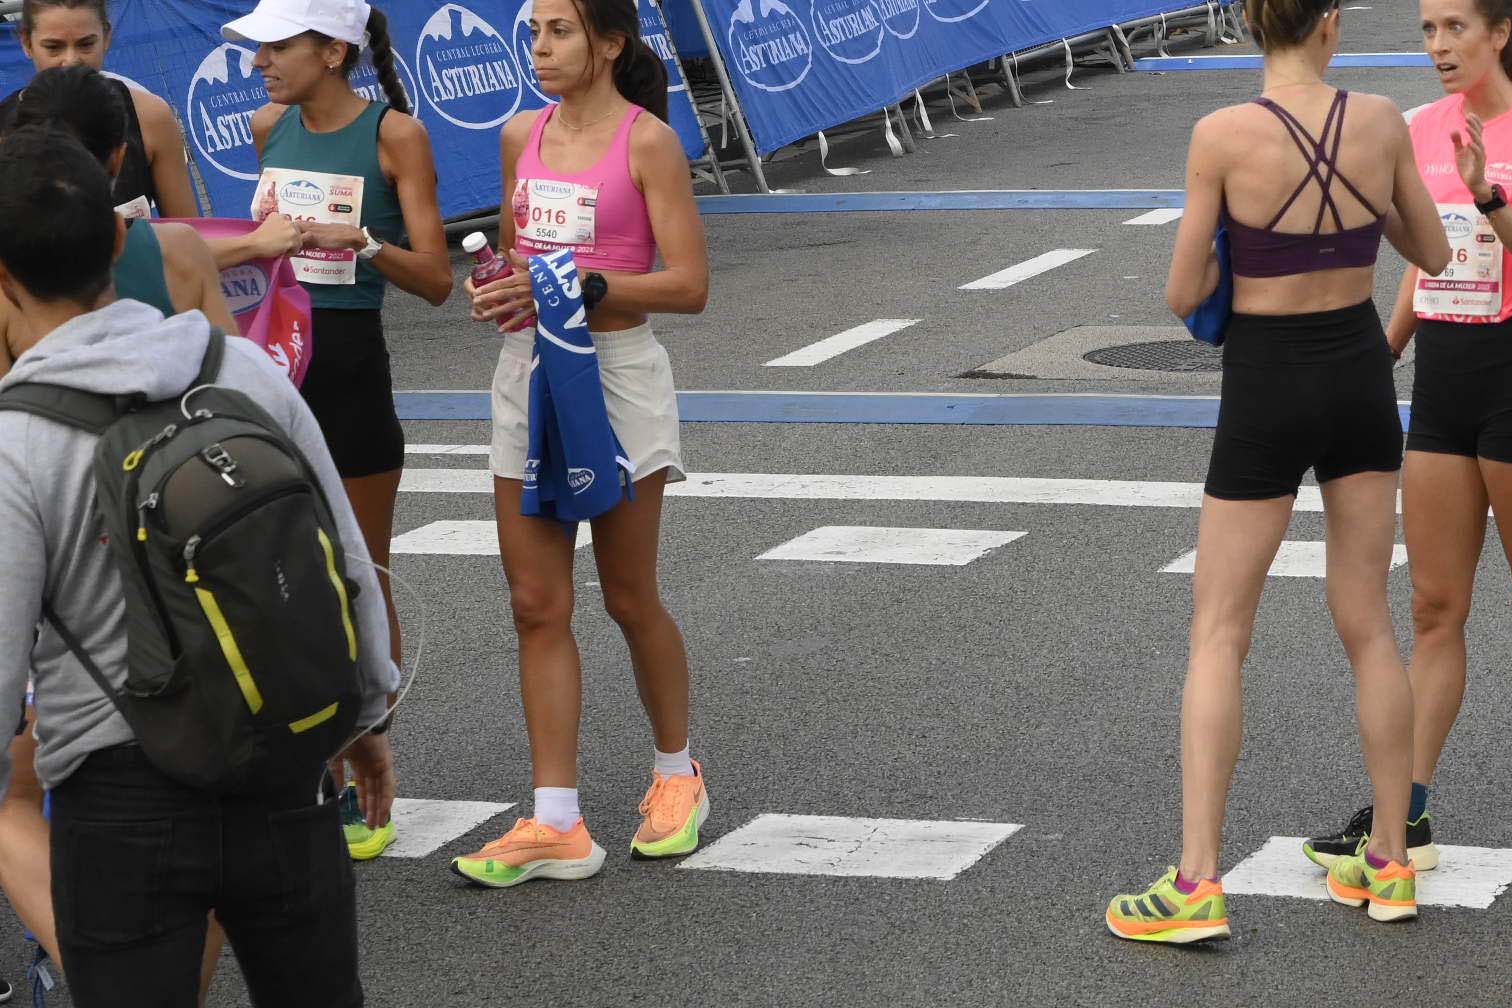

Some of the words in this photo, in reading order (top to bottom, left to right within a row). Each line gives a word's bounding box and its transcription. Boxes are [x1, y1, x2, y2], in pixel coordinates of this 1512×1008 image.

[436, 45, 470, 63] CENTRAL
[426, 53, 518, 103] ASTURIANA
[210, 87, 254, 108] CENTRAL
[532, 207, 567, 225] 016
[535, 228, 558, 239] 5540
[309, 265, 346, 275] Santander
